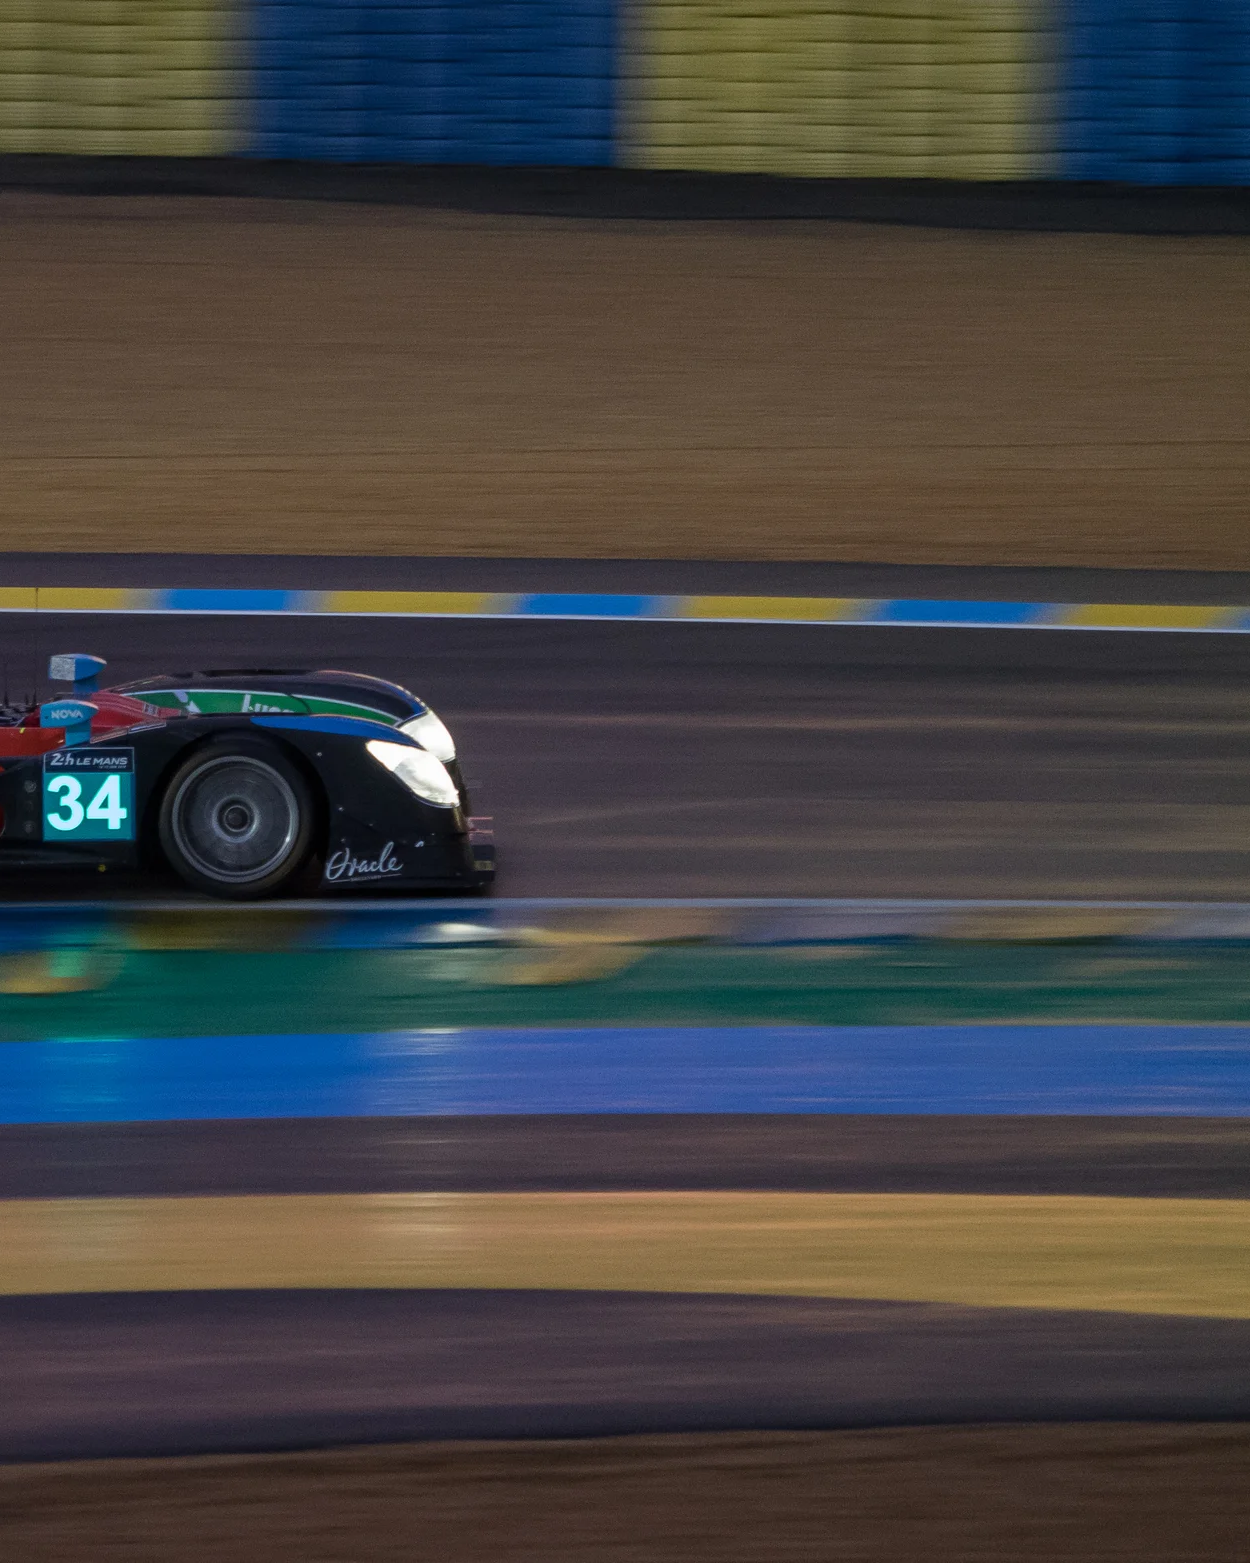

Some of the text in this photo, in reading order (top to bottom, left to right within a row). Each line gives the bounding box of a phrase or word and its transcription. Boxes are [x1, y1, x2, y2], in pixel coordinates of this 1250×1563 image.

[51, 709, 84, 719] NOVA
[75, 757, 92, 766] LE
[92, 757, 128, 766] MANS
[47, 774, 128, 831] 34
[326, 842, 404, 880] Oracle
